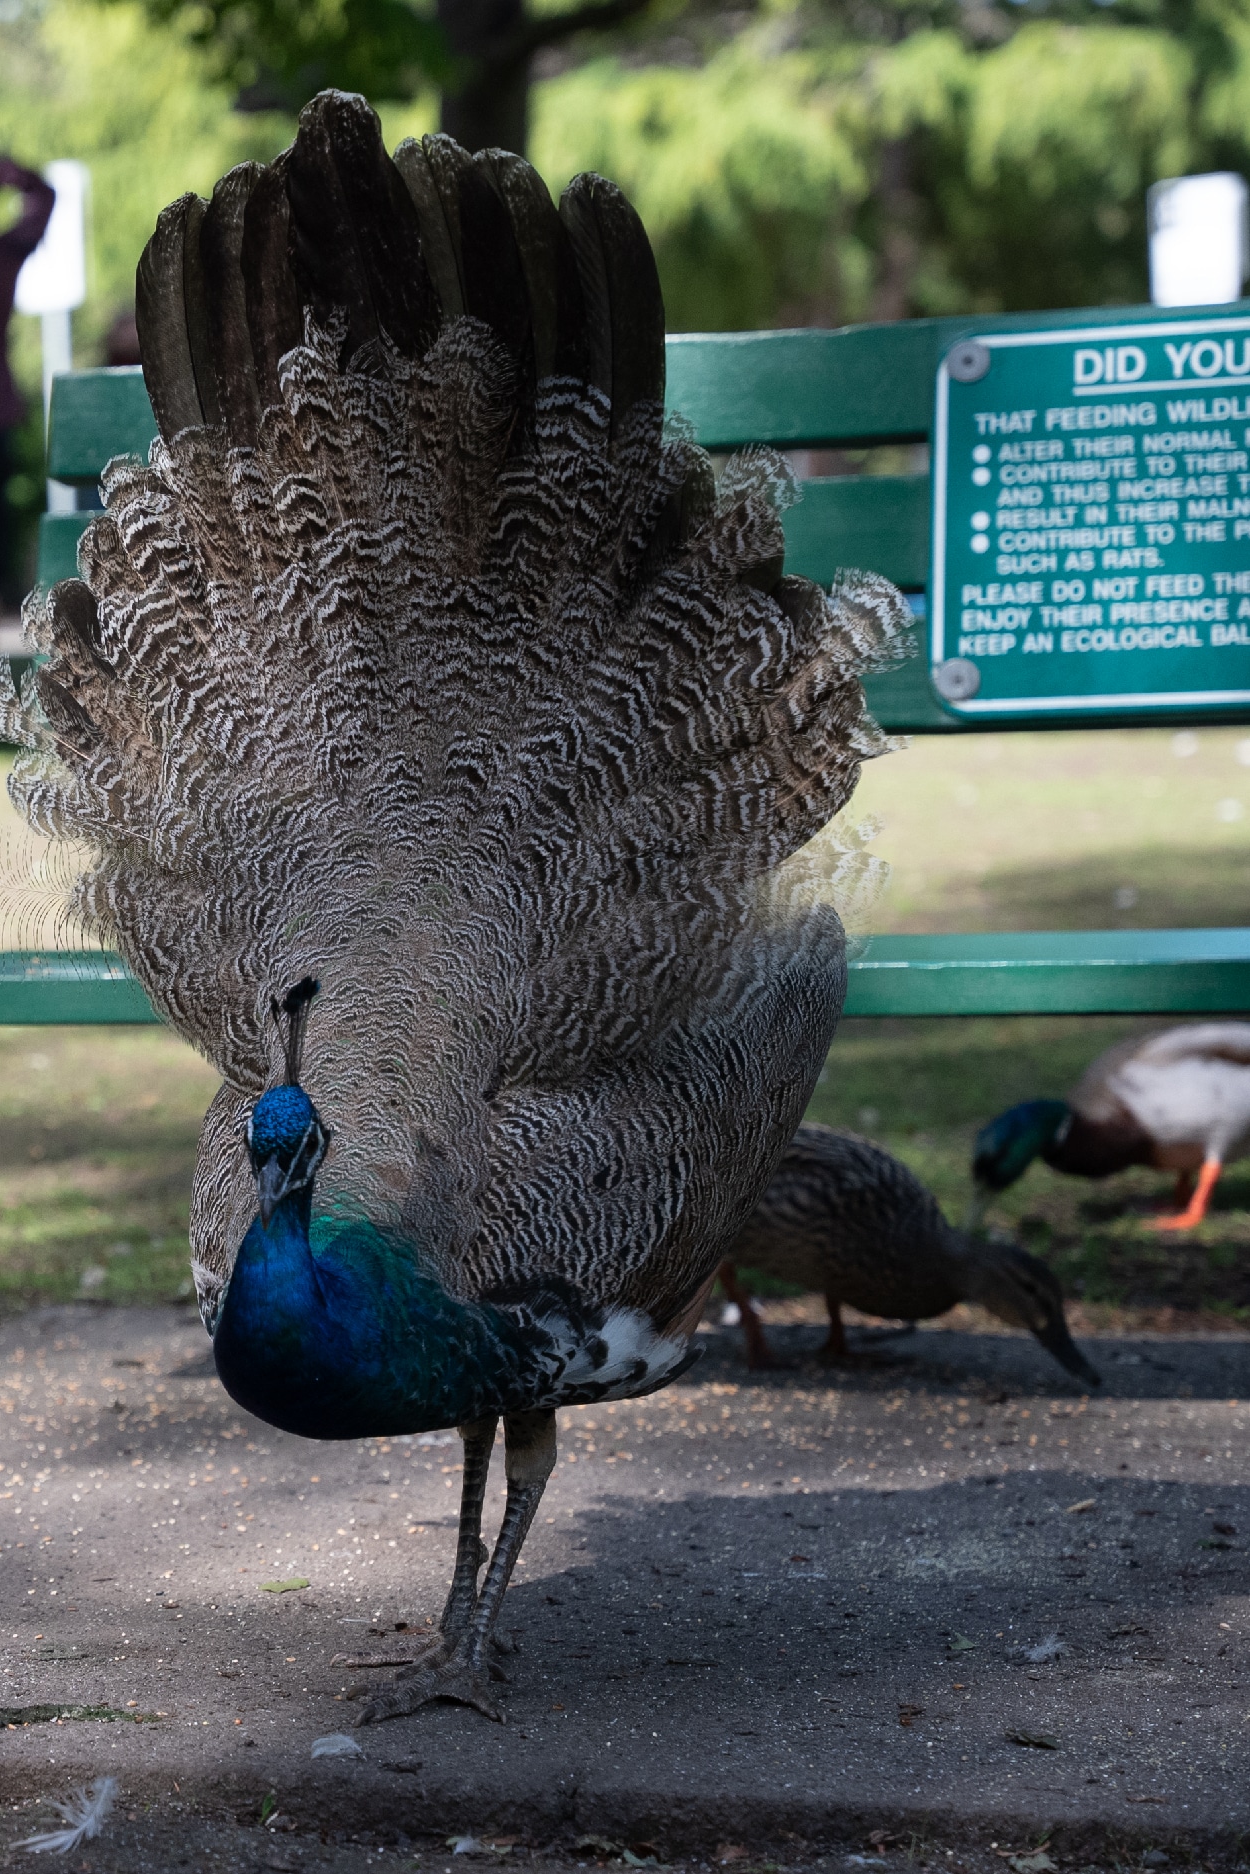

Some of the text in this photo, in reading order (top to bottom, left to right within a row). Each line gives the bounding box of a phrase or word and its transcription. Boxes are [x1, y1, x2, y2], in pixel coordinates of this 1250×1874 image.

[1074, 339, 1250, 385] DID YOU
[974, 409, 1037, 435] THAT
[1045, 402, 1157, 431] FEEDING
[998, 440, 1064, 462] ALTER
[1072, 435, 1134, 458] THEIR
[1143, 429, 1237, 454] NORMAL
[999, 451, 1248, 485] CONTRIBUTE TO THEIR
[997, 485, 1044, 508] AND
[1051, 481, 1110, 504] THUS
[1117, 475, 1228, 501] INCREASE
[996, 506, 1078, 530] RESULT
[1084, 505, 1108, 525] IN
[1115, 500, 1179, 523] THEIR
[997, 525, 1137, 553] CONTRIBUTE
[1144, 522, 1175, 545] TO
[1182, 520, 1227, 543] THE
[996, 547, 1165, 575] SUCH AS RATS.
[961, 581, 1044, 606] PLEASE
[1051, 579, 1086, 602] DO
[1092, 576, 1140, 600] NOT
[1146, 573, 1205, 598] FEED
[961, 607, 1032, 632] ENJOY
[1039, 603, 1103, 628] THEIR
[1110, 597, 1229, 625] PRESENCE
[958, 623, 1250, 656] KEEP AN ECOLOGICAL BAL
